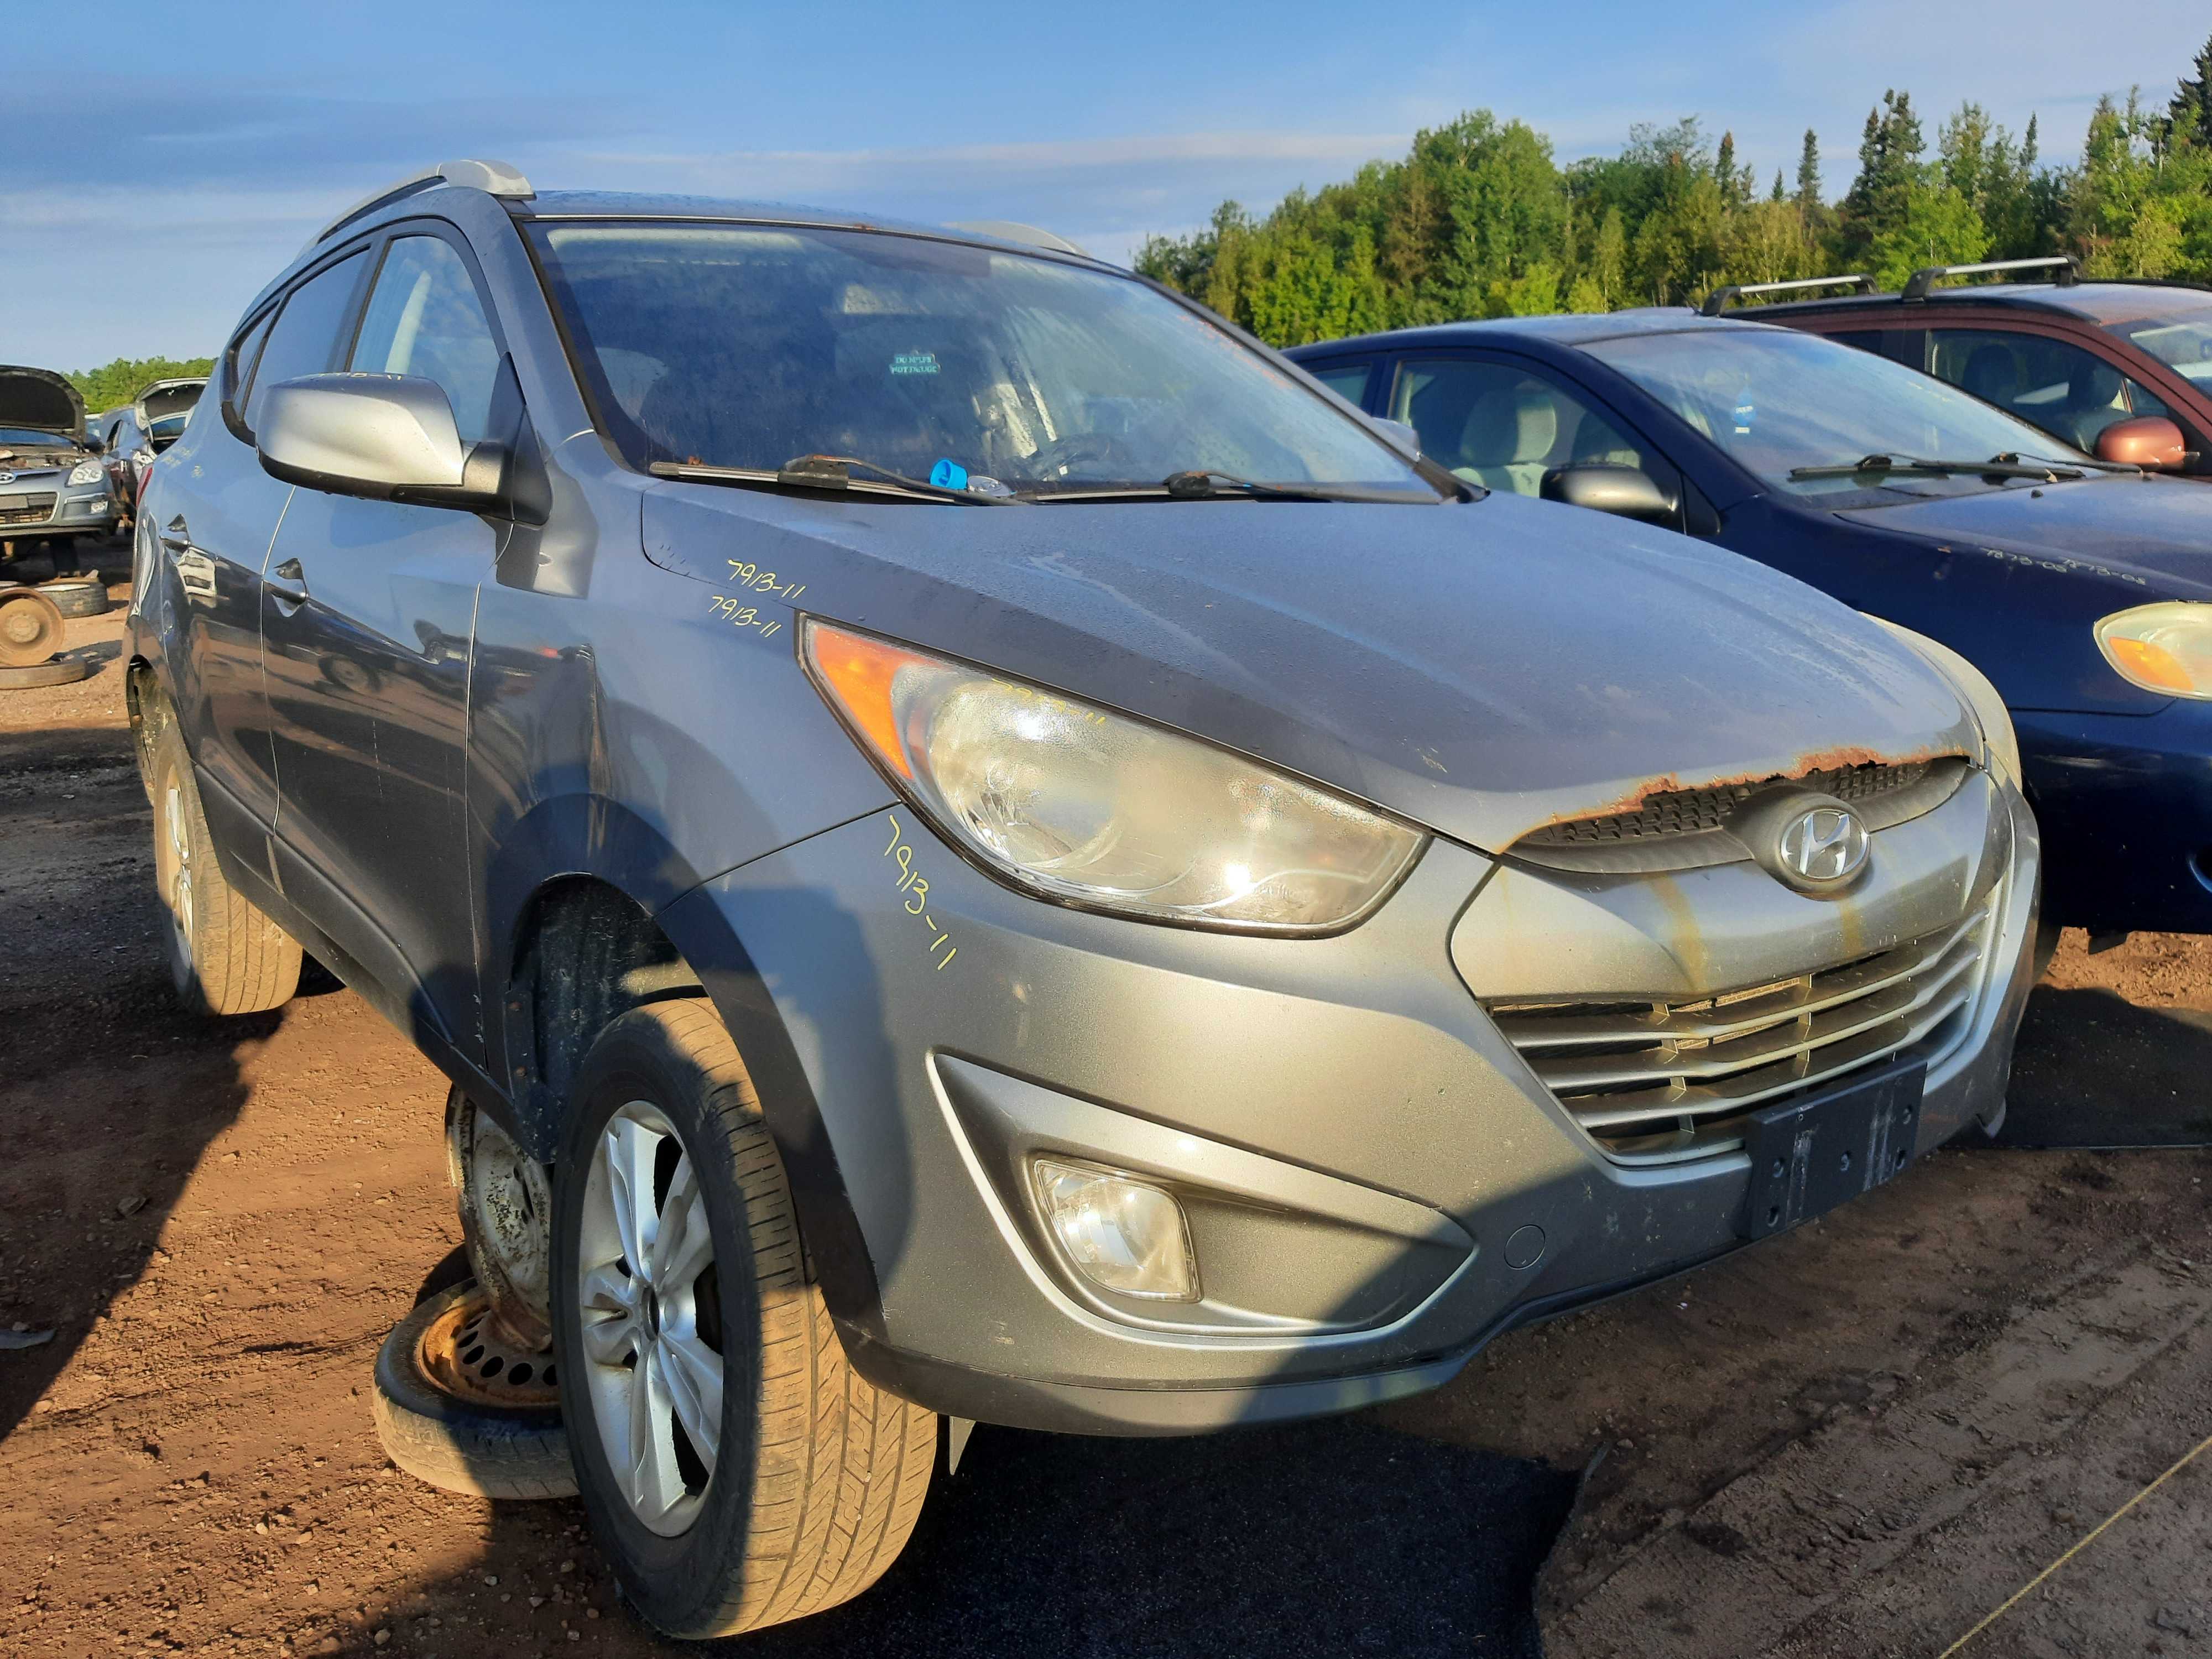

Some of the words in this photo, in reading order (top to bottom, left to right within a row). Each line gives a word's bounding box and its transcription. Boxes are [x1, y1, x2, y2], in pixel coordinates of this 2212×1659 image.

[727, 559, 807, 599] 7913-11
[707, 595, 782, 638] 7913-11
[884, 814, 957, 971] 7913-11
